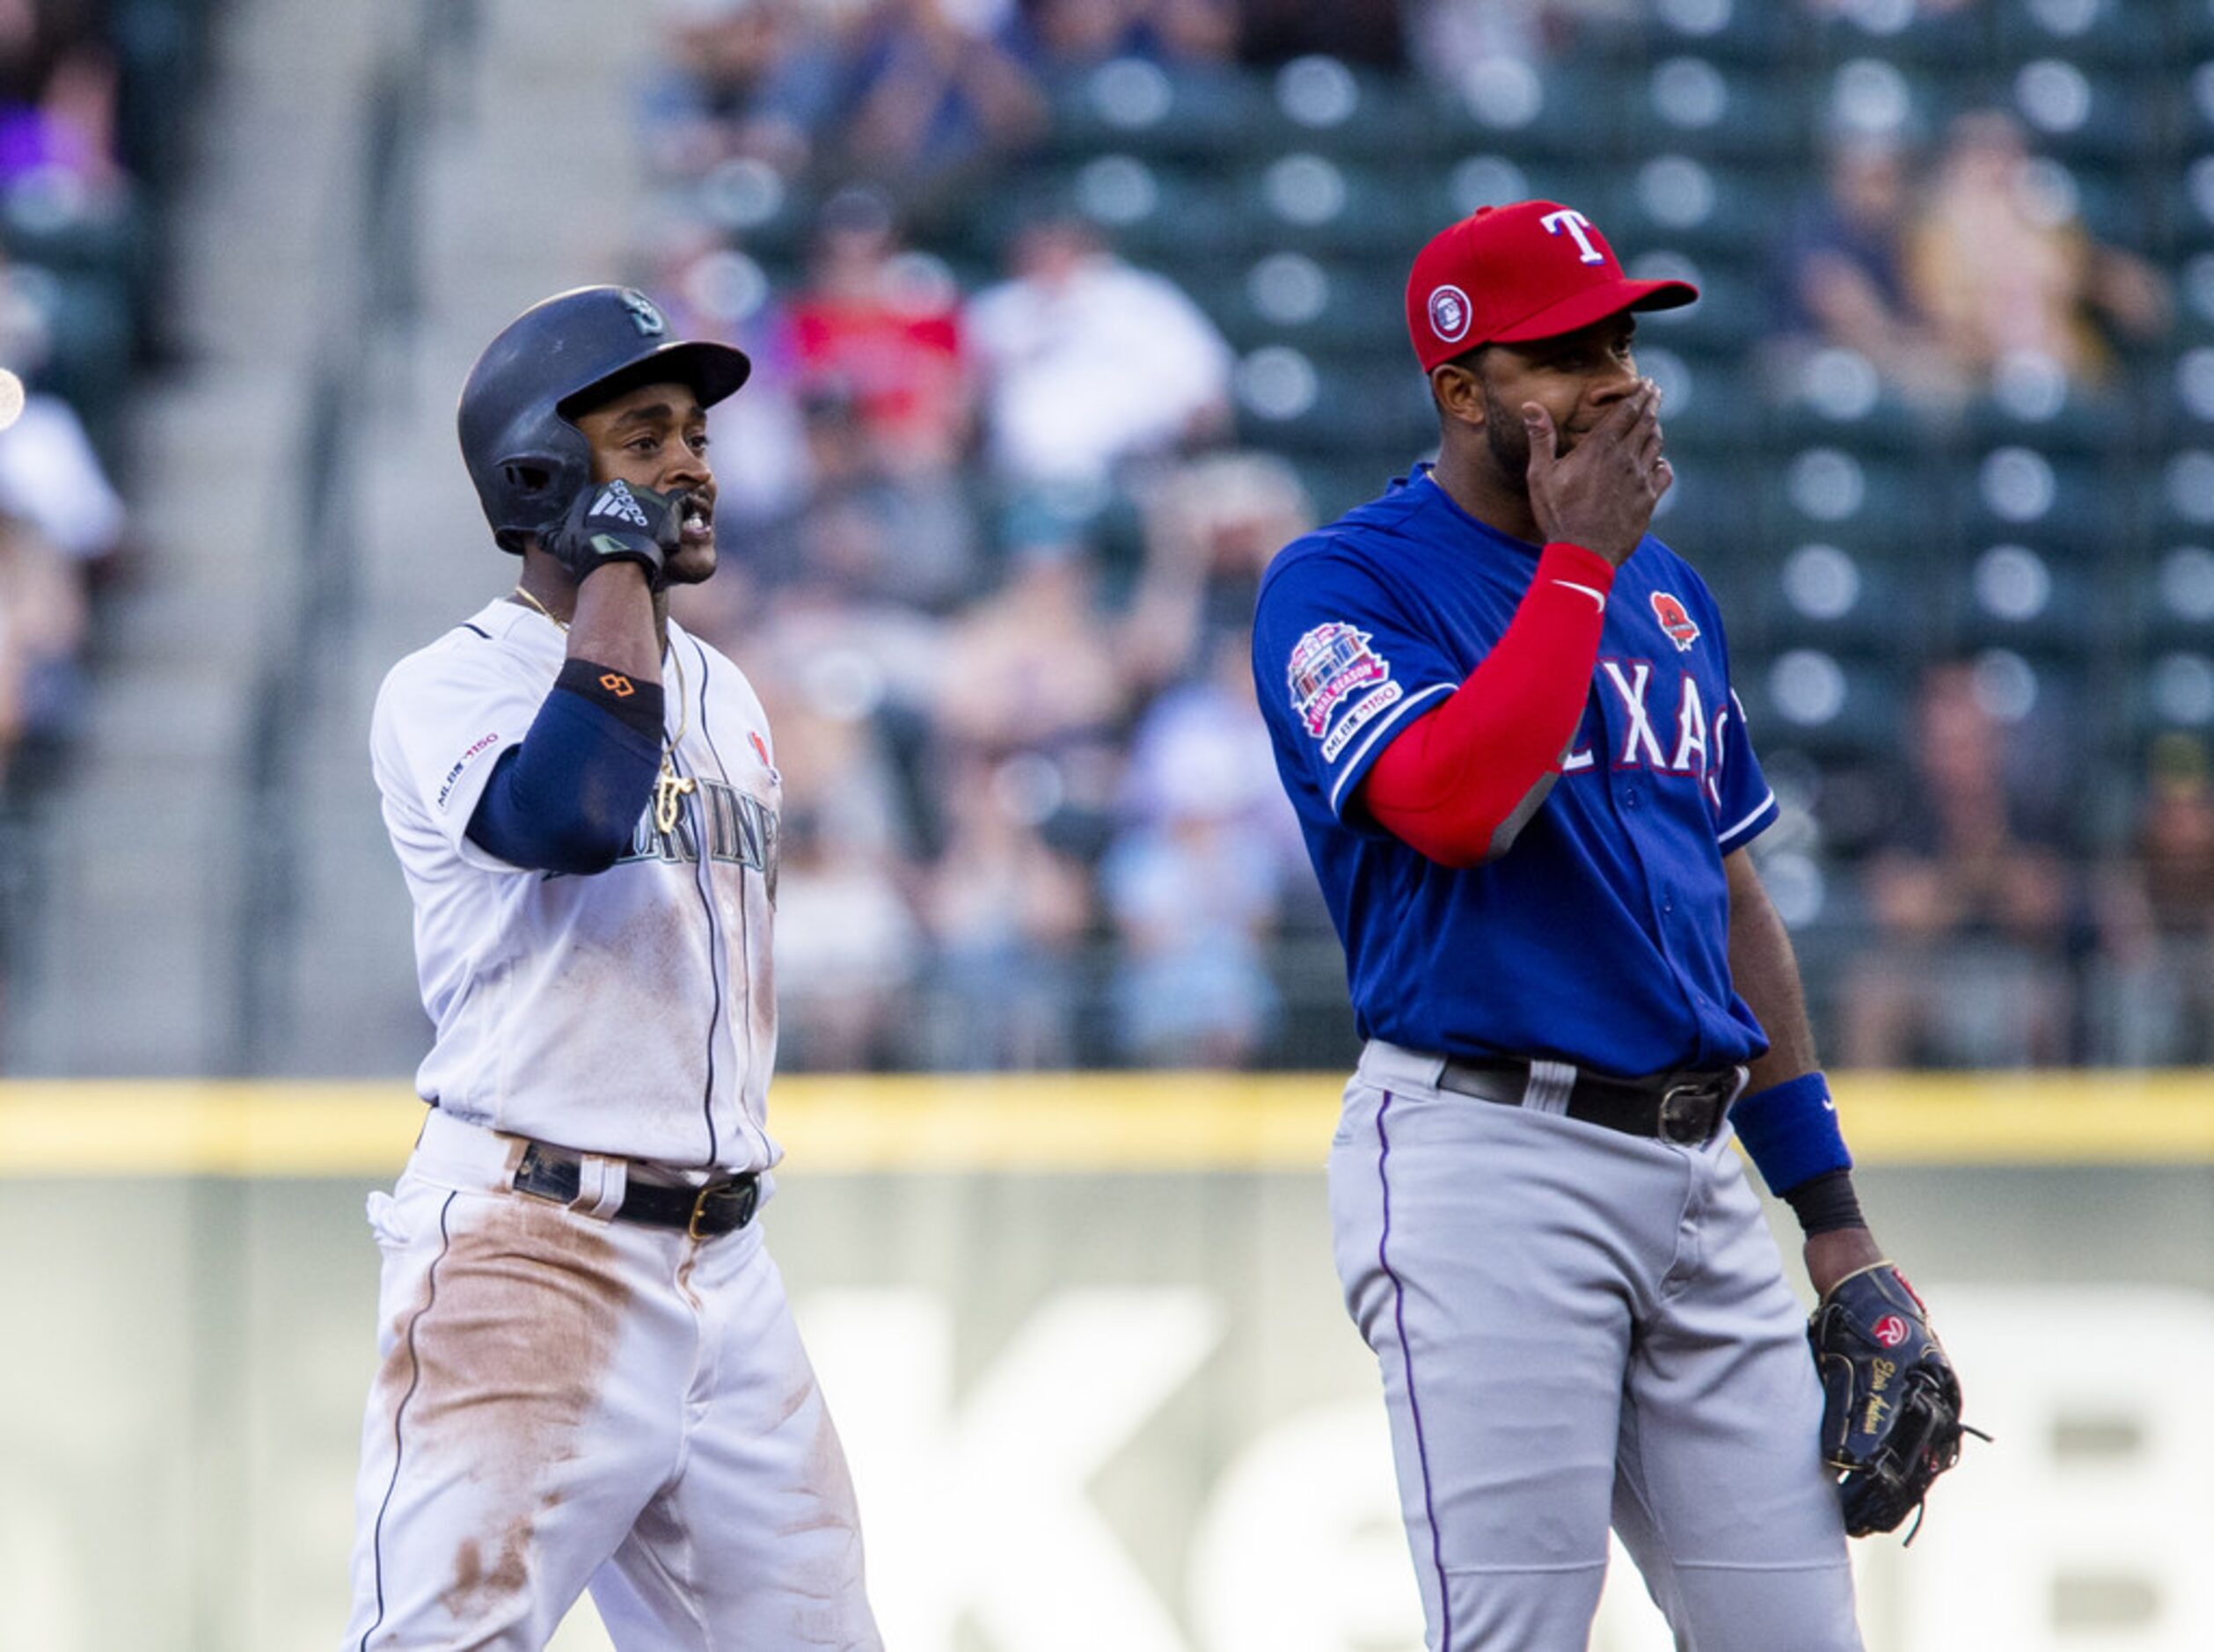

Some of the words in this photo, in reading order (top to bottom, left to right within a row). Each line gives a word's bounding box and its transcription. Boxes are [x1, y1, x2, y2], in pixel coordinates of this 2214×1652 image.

[1540, 210, 1604, 267] T
[609, 479, 649, 527] adidas
[1331, 662, 1373, 695] SEASON
